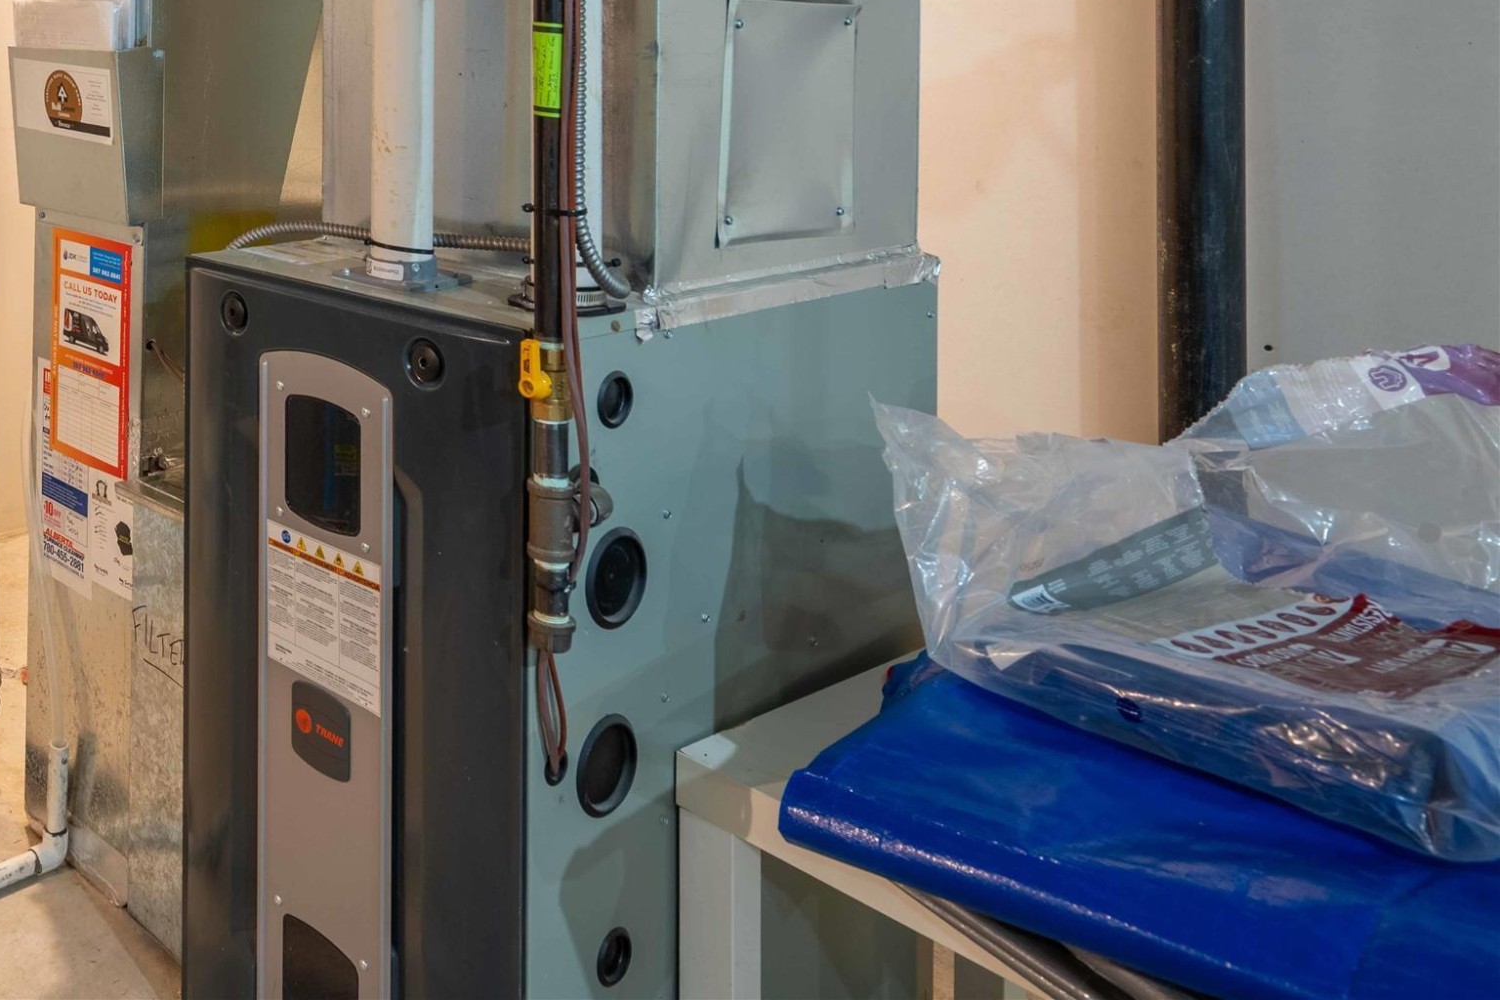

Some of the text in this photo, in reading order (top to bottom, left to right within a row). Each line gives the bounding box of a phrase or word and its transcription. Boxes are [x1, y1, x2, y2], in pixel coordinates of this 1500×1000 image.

[64, 281, 118, 304] CALL US TODAY
[43, 528, 73, 549] ALBERTA
[315, 723, 345, 748] TRANE
